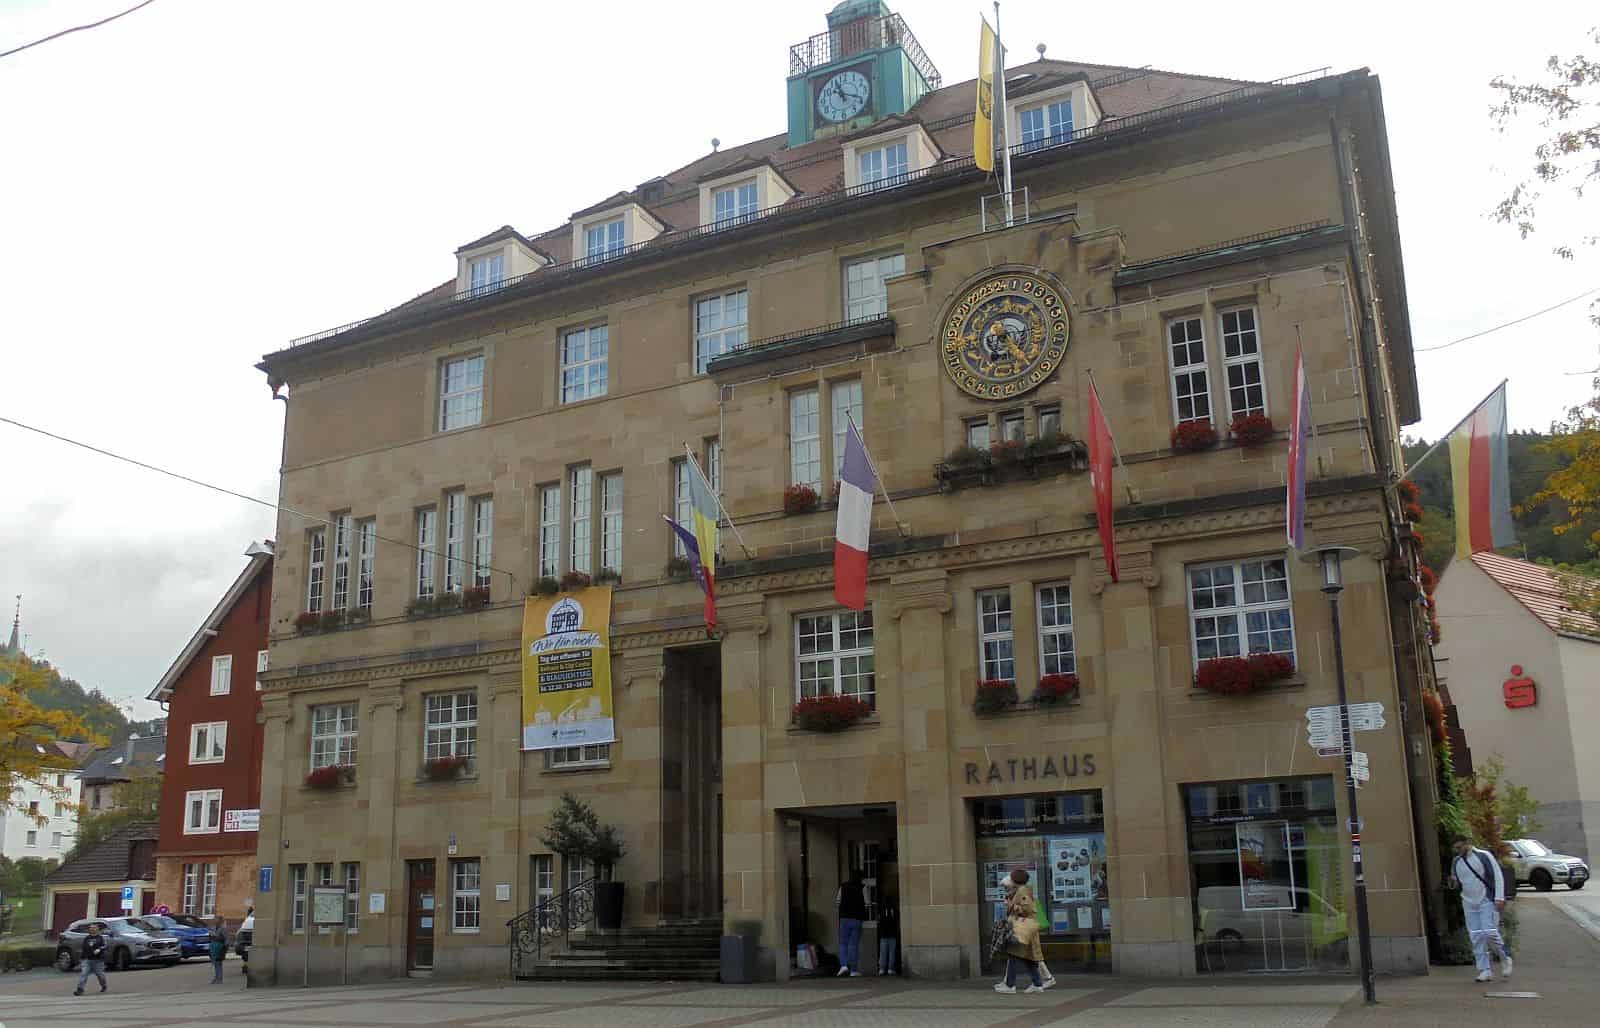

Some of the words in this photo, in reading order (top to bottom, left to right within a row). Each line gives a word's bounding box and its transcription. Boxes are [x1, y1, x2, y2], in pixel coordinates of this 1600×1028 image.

[994, 280, 1007, 292] 24
[1024, 282, 1032, 292] 2
[980, 286, 993, 297] 23
[1035, 288, 1044, 297] 3
[1045, 296, 1055, 306] 4
[1051, 307, 1062, 317] 5
[1054, 321, 1064, 331] 6
[1053, 334, 1064, 345] 7
[1049, 349, 1060, 358] 8
[1041, 362, 1051, 371] 9
[1004, 384, 1015, 393] 12
[965, 753, 1096, 785] RATHAUS
[124, 887, 132, 899] P
